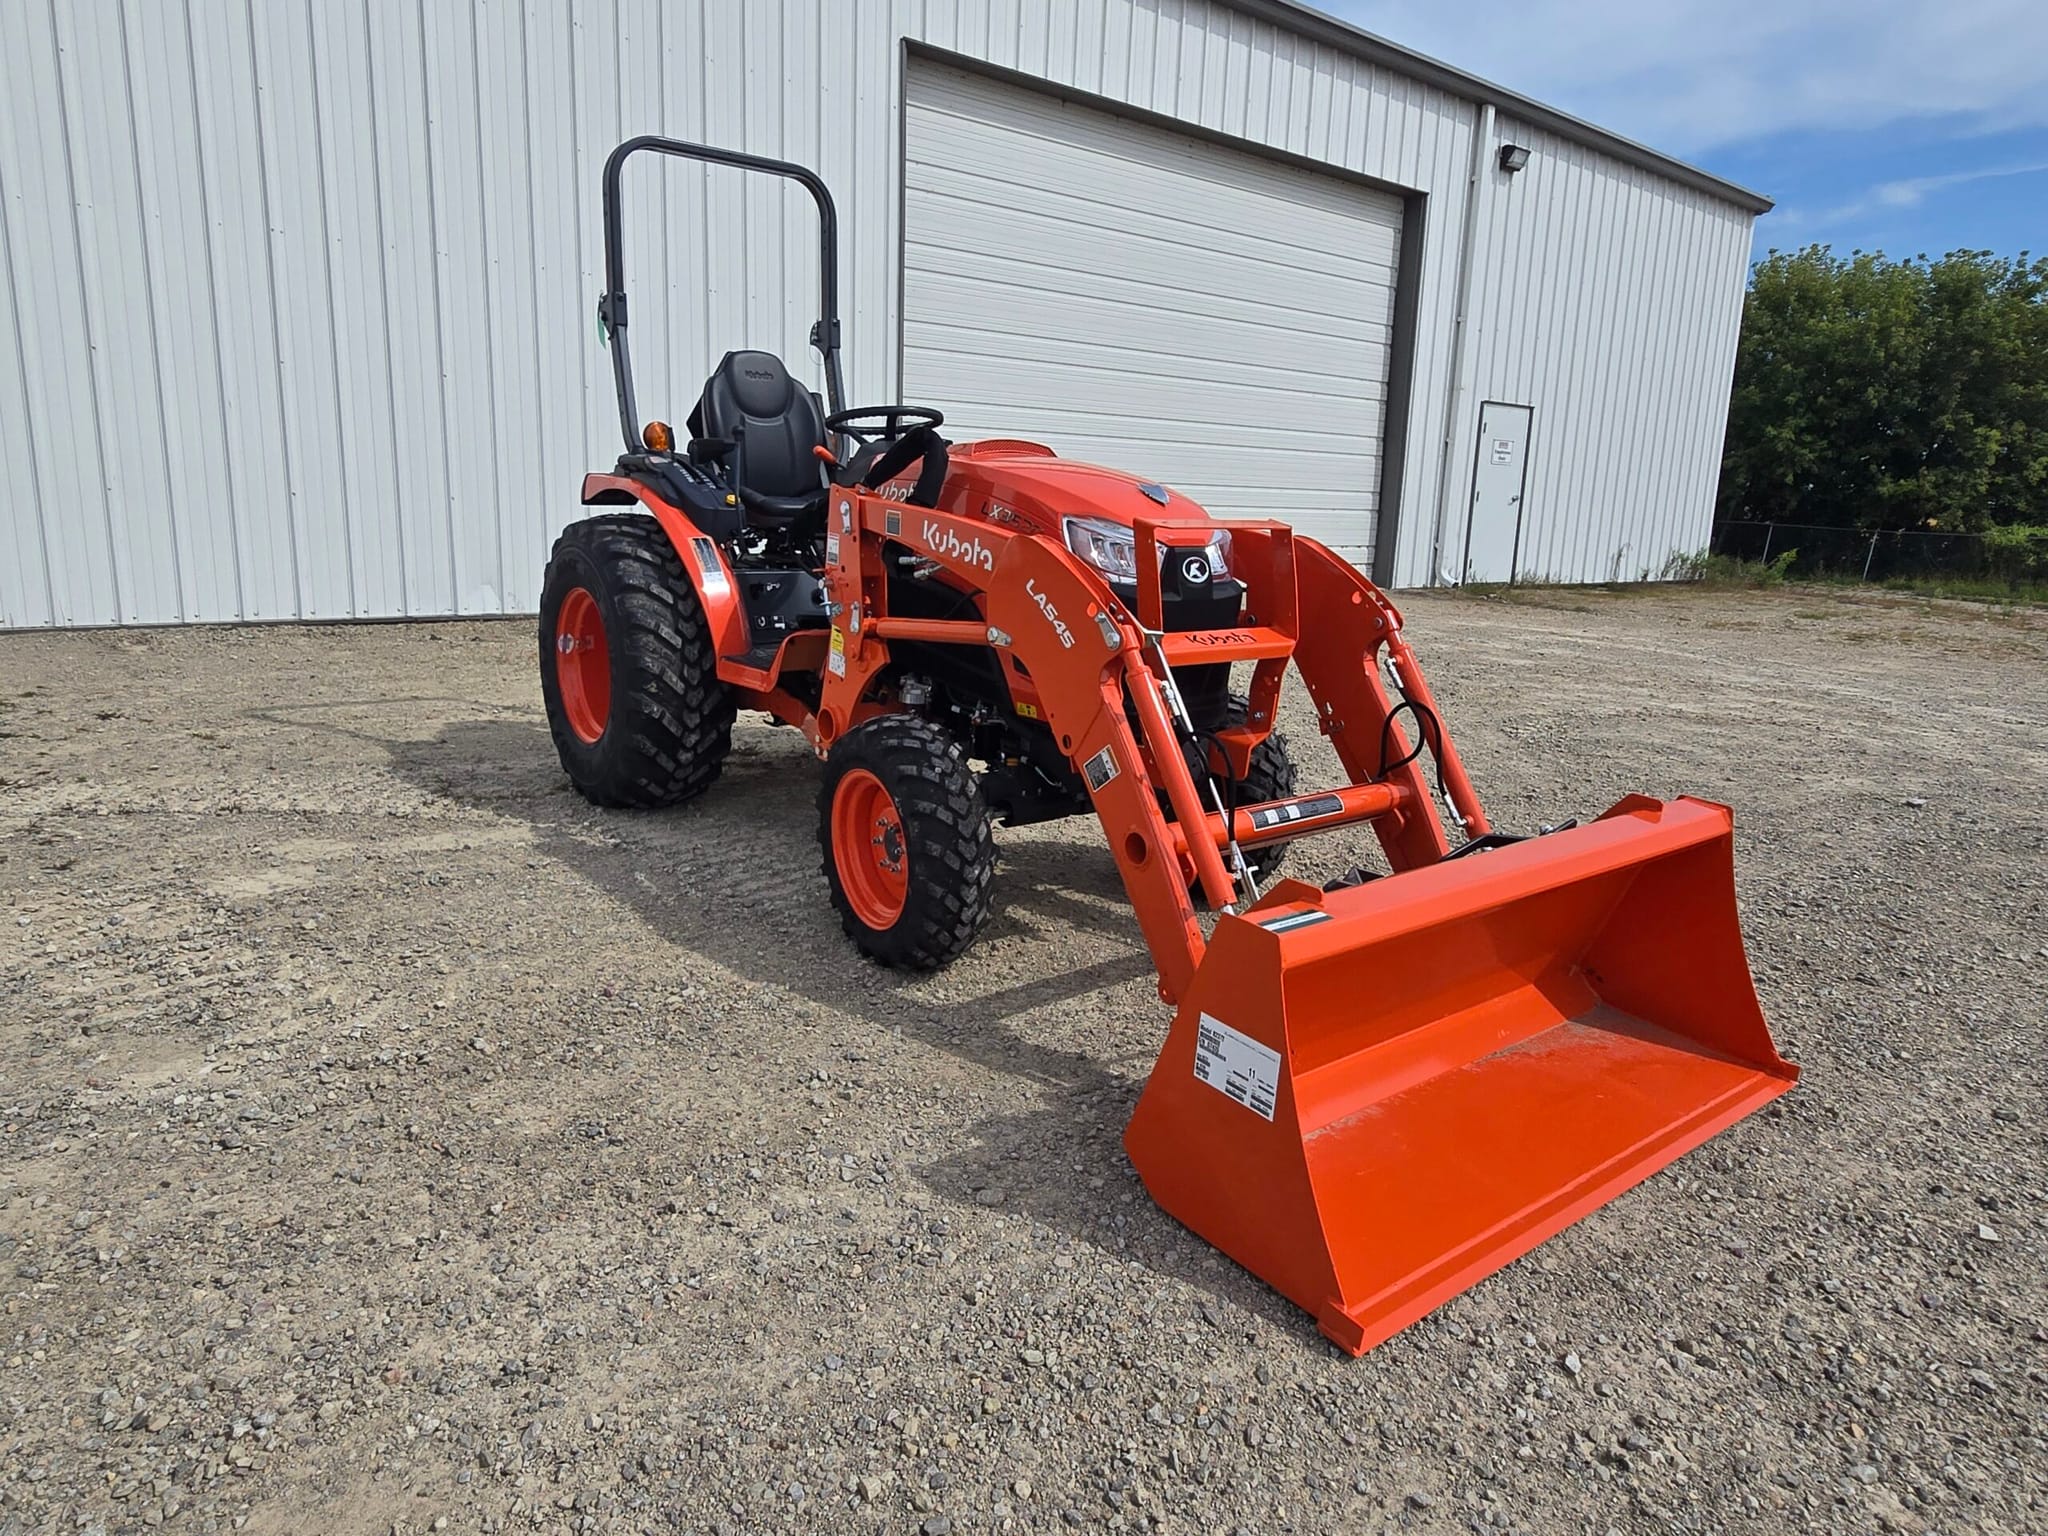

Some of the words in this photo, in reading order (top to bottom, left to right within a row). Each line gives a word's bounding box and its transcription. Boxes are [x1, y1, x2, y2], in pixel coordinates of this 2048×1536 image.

[922, 519, 993, 571] Kubota
[1025, 578, 1076, 649] LA545
[1184, 632, 1257, 645] Kubota
